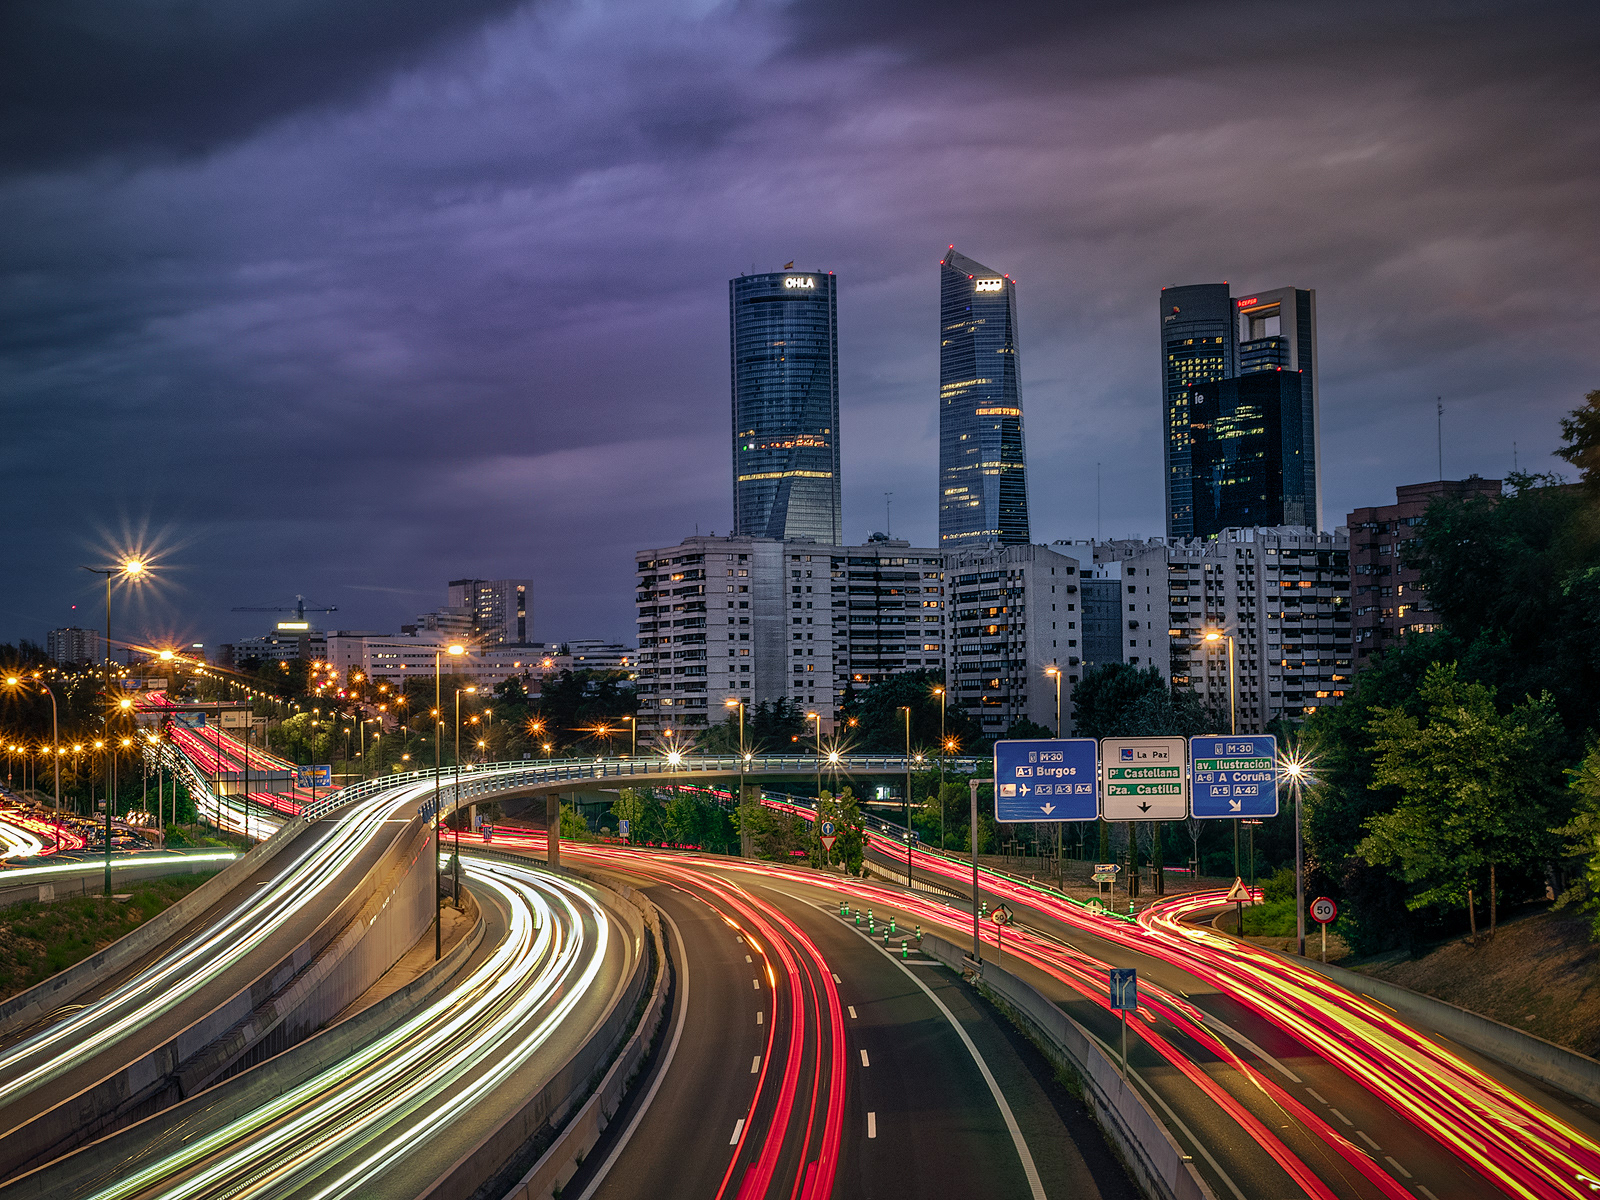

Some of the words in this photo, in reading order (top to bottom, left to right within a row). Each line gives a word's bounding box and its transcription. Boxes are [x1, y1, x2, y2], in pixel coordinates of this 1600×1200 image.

[785, 277, 814, 288] OHLA
[1195, 392, 1204, 404] ie
[1228, 745, 1252, 753] M-30
[1040, 753, 1062, 761] M-30
[1152, 751, 1168, 759] Paz
[1197, 762, 1211, 770] av.
[1216, 759, 1270, 770] Ilustración
[1017, 768, 1032, 776] A-1
[1036, 767, 1077, 778] Burgos
[1124, 768, 1179, 778] Castellana
[1197, 774, 1212, 782] A-6
[1218, 773, 1227, 782] A
[1232, 772, 1271, 782] Coruña
[1056, 785, 1072, 793] A-3
[1076, 785, 1092, 793] A-4
[1109, 785, 1131, 795] Pza.
[1137, 784, 1180, 794] Castilla
[1212, 787, 1229, 795] A-5
[1235, 786, 1257, 794] A-42
[1317, 905, 1331, 915] 50
